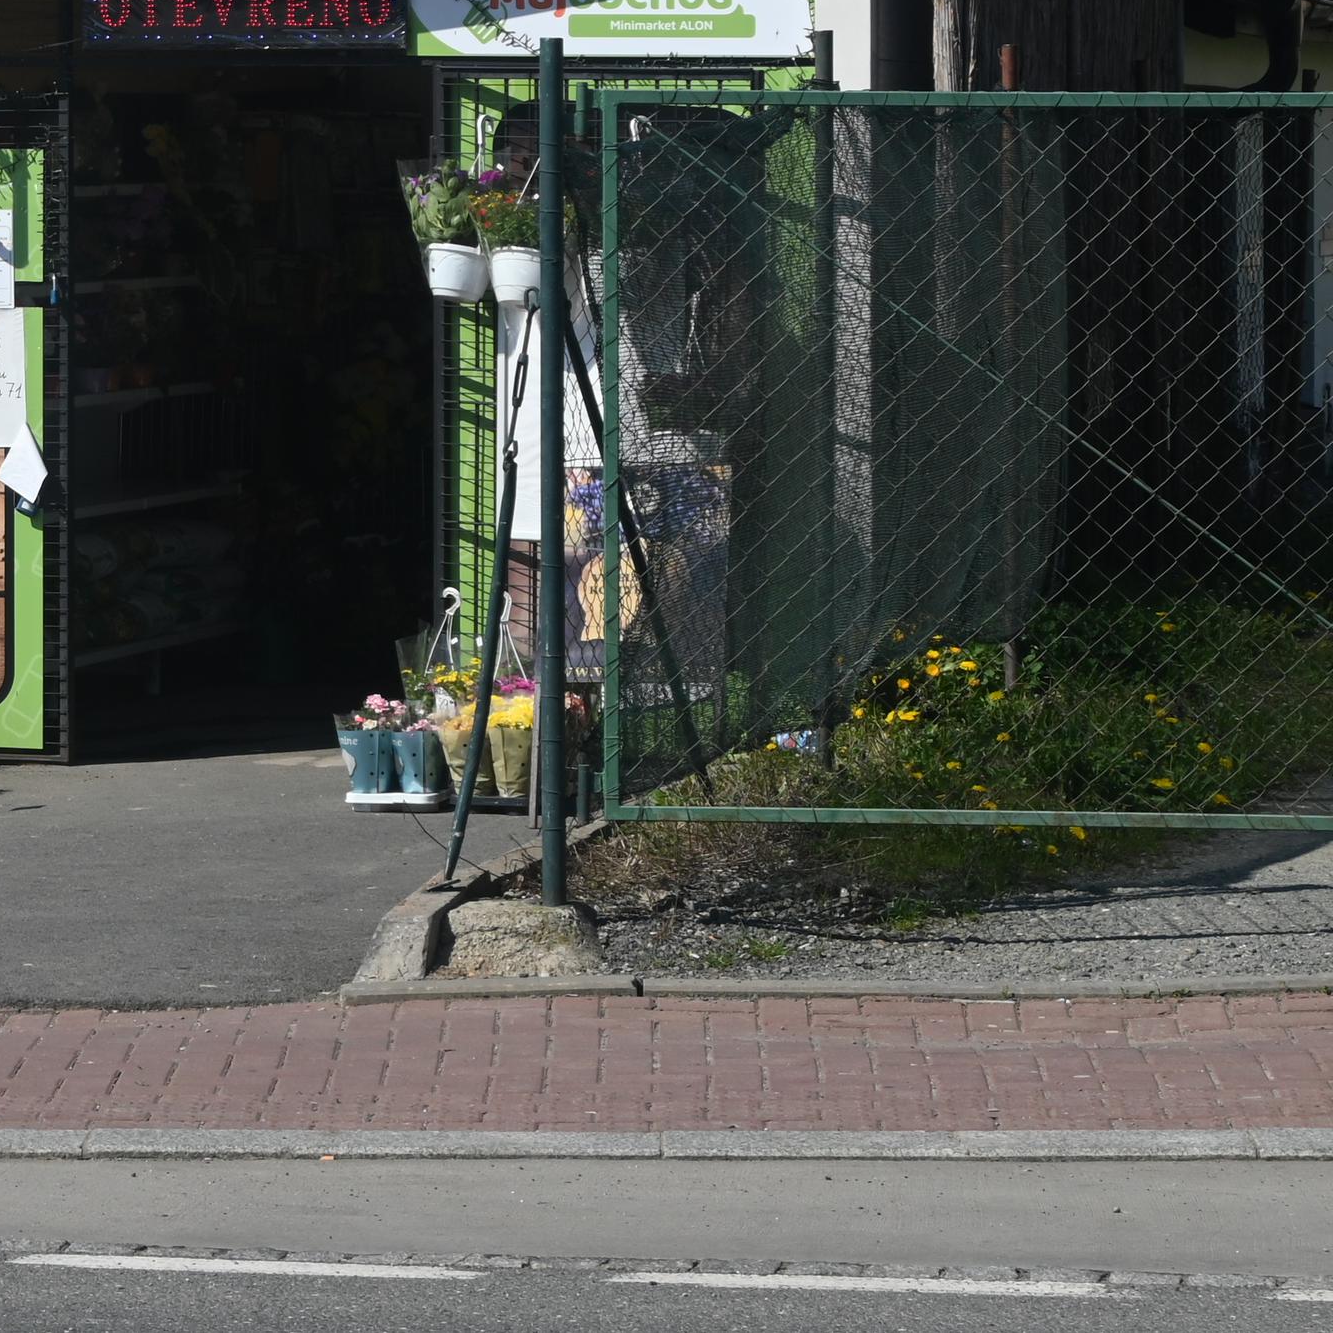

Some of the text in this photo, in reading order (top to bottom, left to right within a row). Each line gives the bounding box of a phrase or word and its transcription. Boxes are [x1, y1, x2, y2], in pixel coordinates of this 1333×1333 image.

[609, 19, 713, 31] Minimarket ALON
[5, 381, 24, 399] 71
